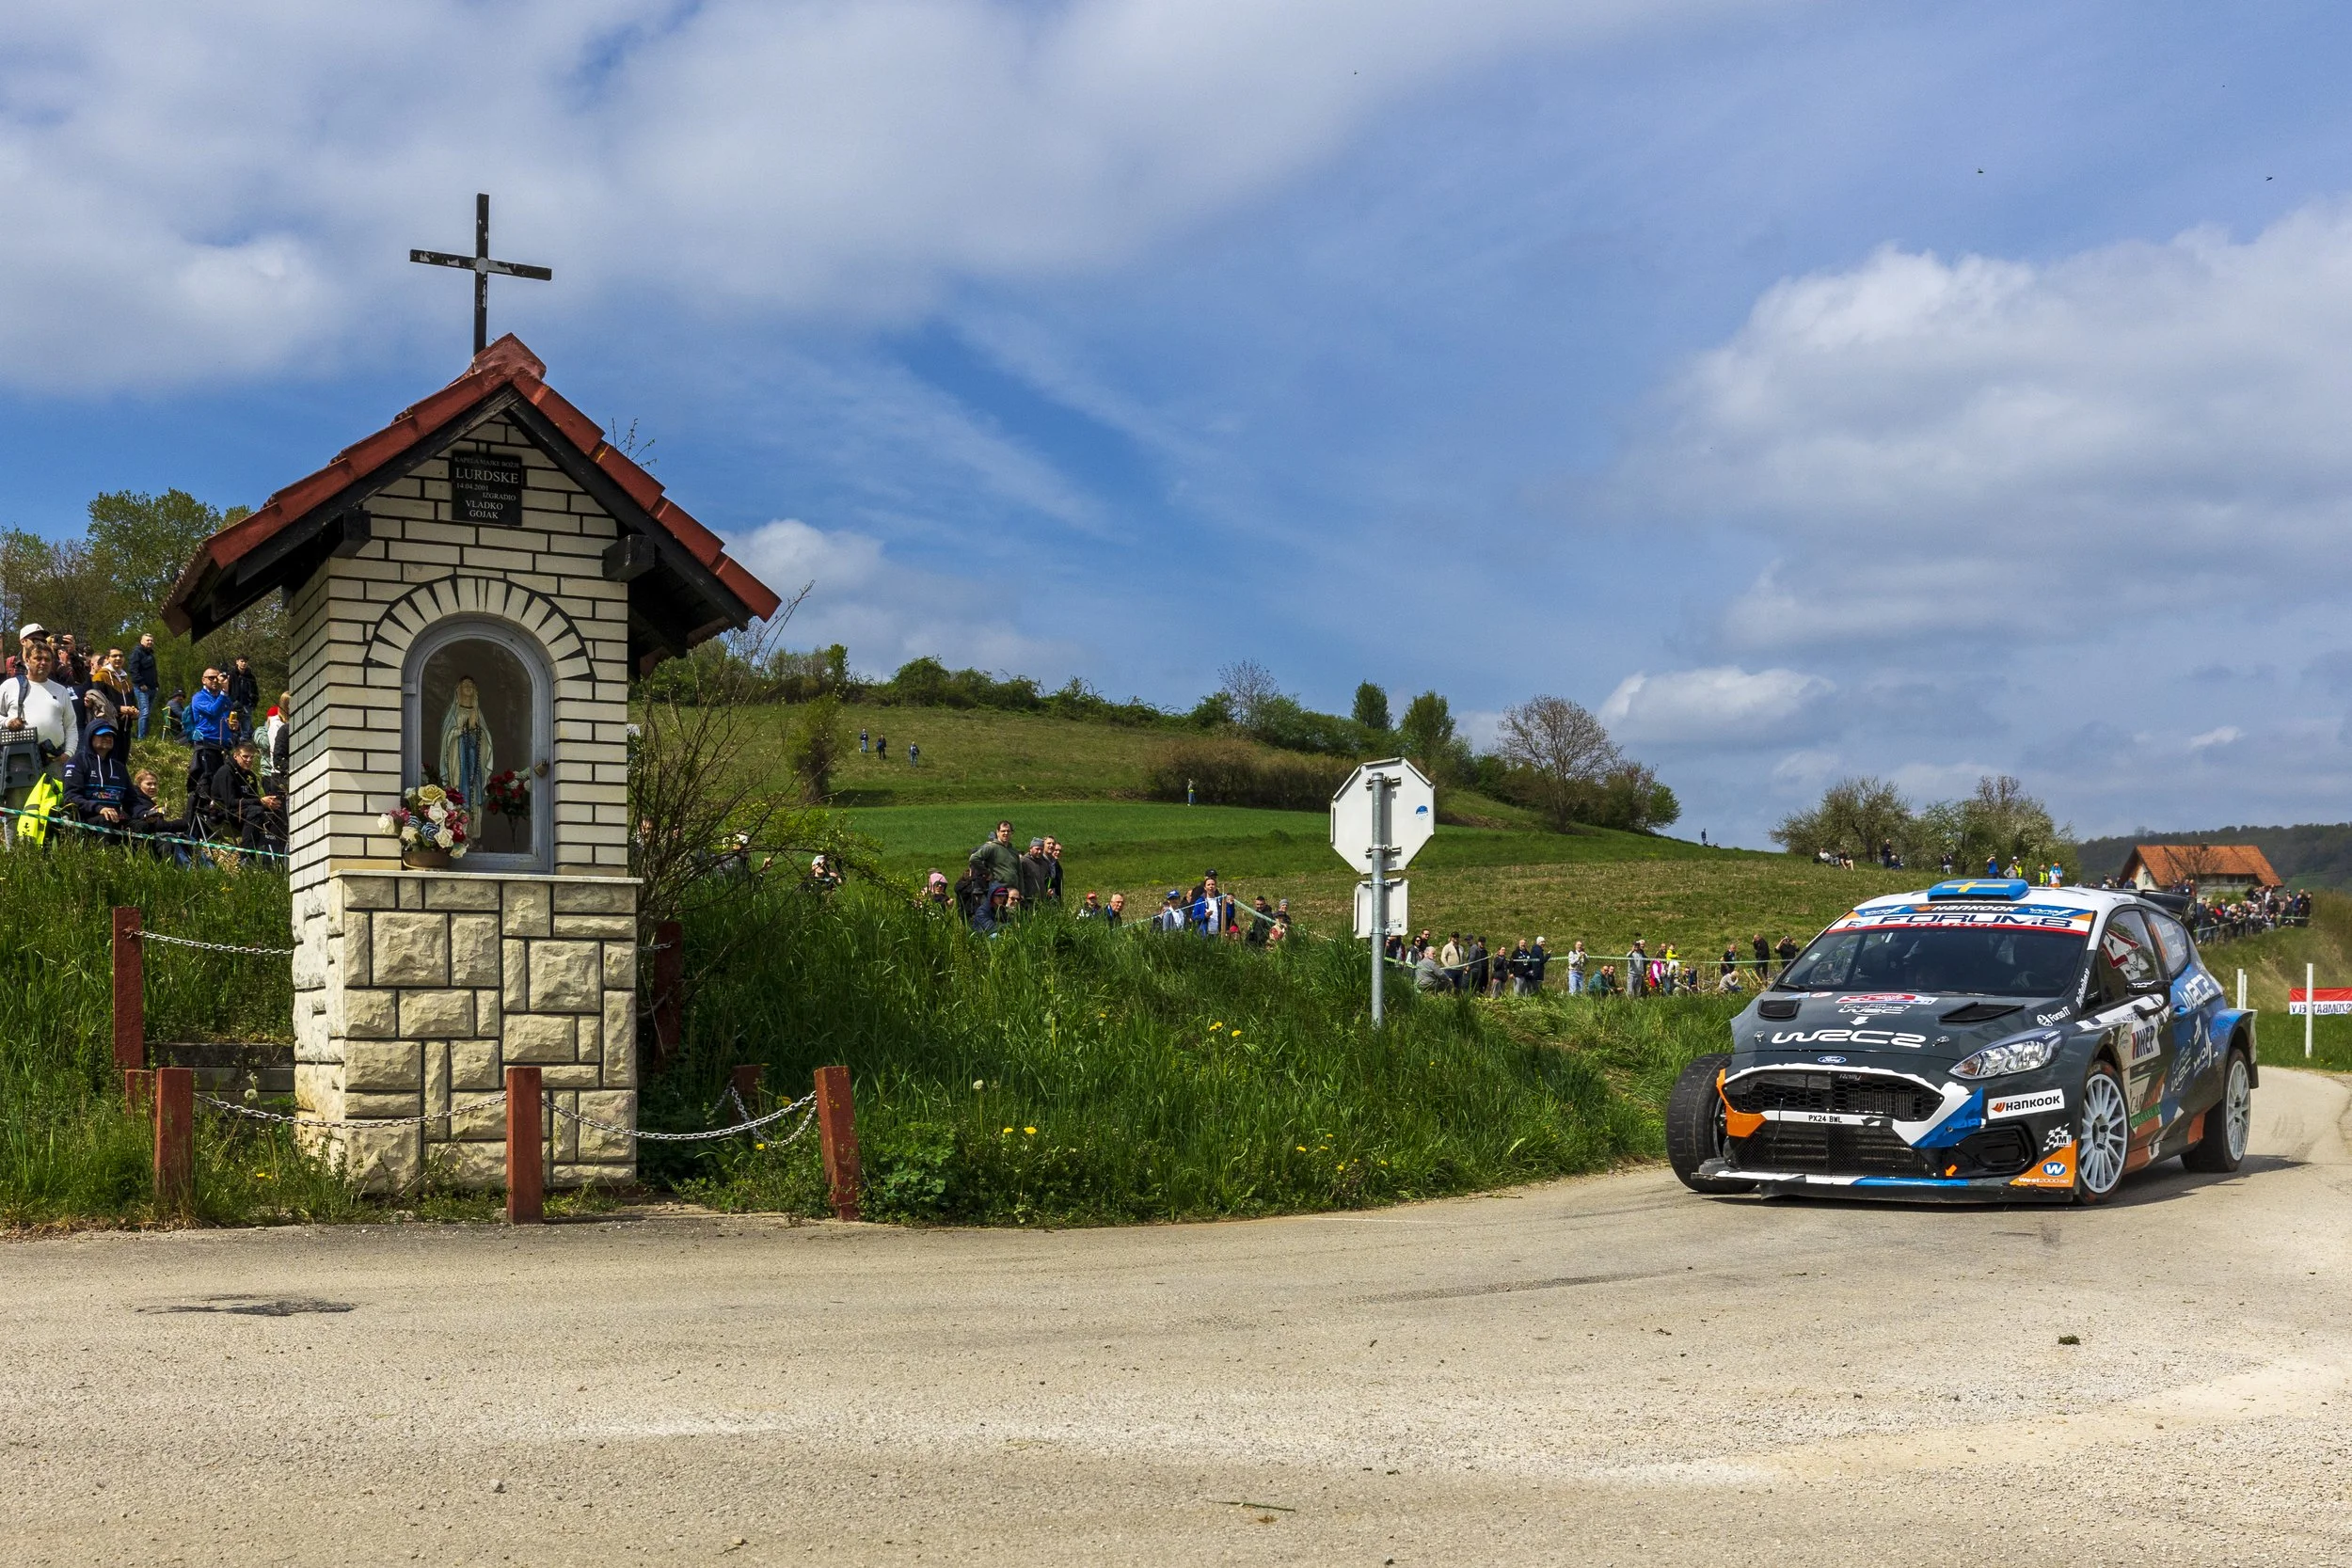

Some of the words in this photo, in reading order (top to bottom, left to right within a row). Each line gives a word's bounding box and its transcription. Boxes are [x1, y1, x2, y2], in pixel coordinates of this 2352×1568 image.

[455, 467, 518, 483] LURDSKE
[483, 492, 516, 500] IZGRADIO
[465, 499, 503, 510] VLADKO
[469, 510, 499, 519] GOJAK
[1879, 914, 2073, 928] FORUM8
[1772, 1029, 1927, 1048] WRC2
[1808, 1115, 1827, 1123] PX24
[1829, 1116, 1843, 1124] BWL
[2058, 1134, 2068, 1145] M
[2046, 1163, 2064, 1175] W
